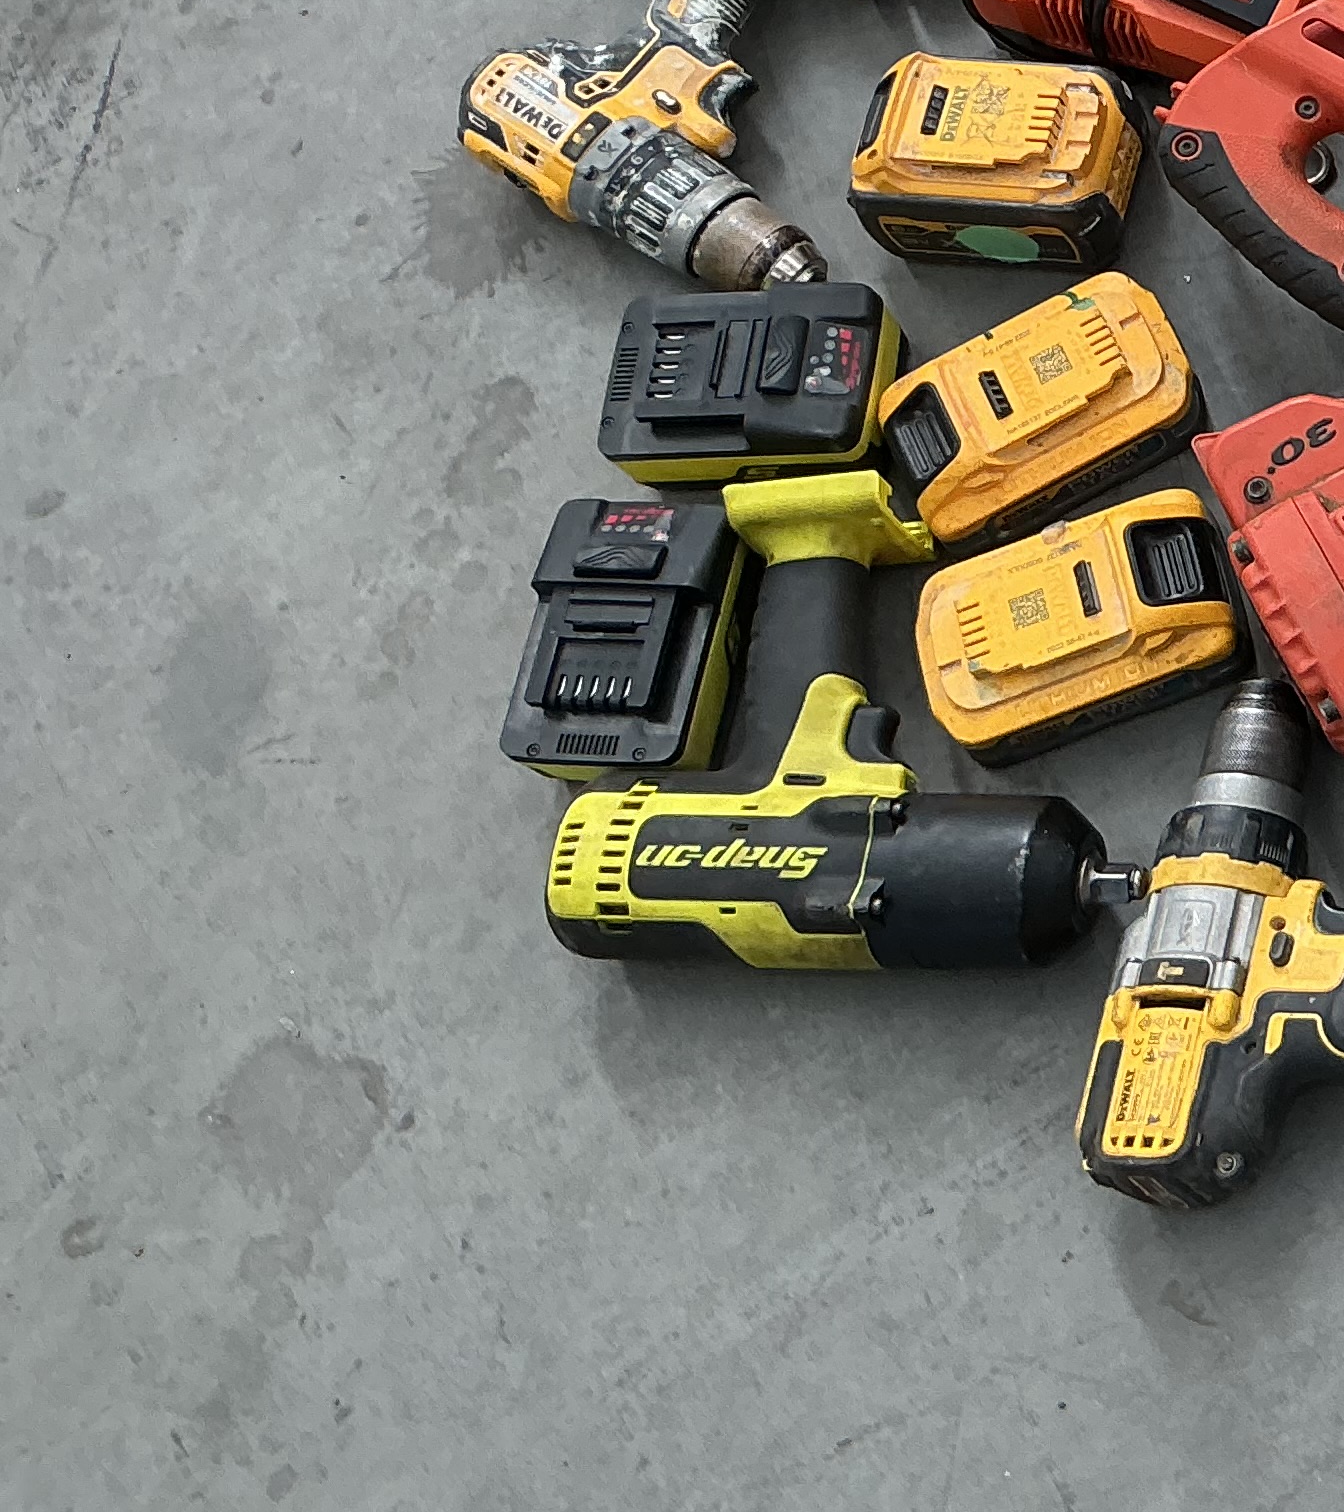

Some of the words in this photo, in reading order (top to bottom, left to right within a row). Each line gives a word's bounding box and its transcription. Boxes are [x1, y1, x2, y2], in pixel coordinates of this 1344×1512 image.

[939, 84, 970, 142] DEWALT
[635, 837, 827, 878] Snap-on
[1114, 1067, 1136, 1121] DEWALT
